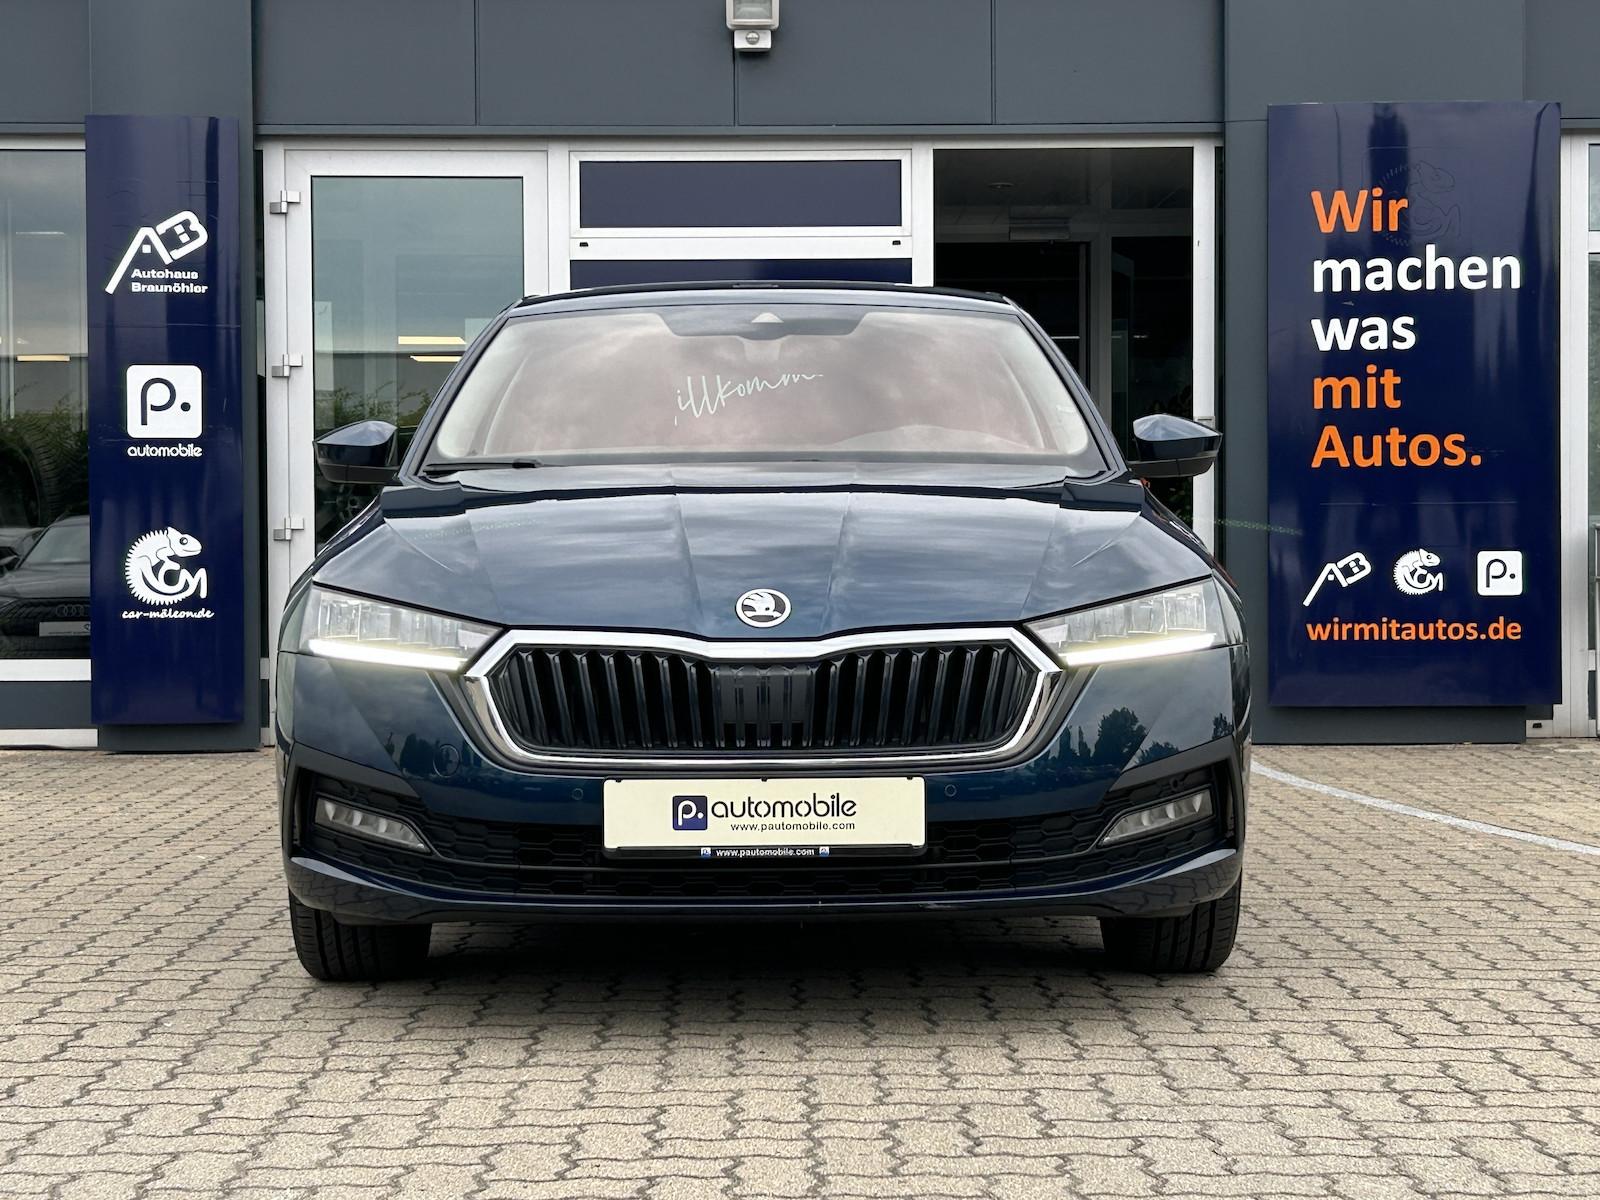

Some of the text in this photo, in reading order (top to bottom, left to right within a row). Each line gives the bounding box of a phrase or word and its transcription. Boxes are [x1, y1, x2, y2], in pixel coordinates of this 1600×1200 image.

[1310, 187, 1409, 233] Wir
[131, 268, 199, 280] Autohaus
[1313, 244, 1521, 292] machen
[131, 281, 208, 294] Braunöhler
[1311, 316, 1416, 351] was
[1313, 364, 1401, 409] mit
[127, 443, 203, 458] automobile
[1311, 425, 1482, 468] Autos.
[1306, 616, 1522, 641] wirmitautos.de
[711, 792, 857, 818] automobile
[730, 821, 856, 833] www.pautomobile.com
[715, 848, 815, 858] www.pautomobile.com
